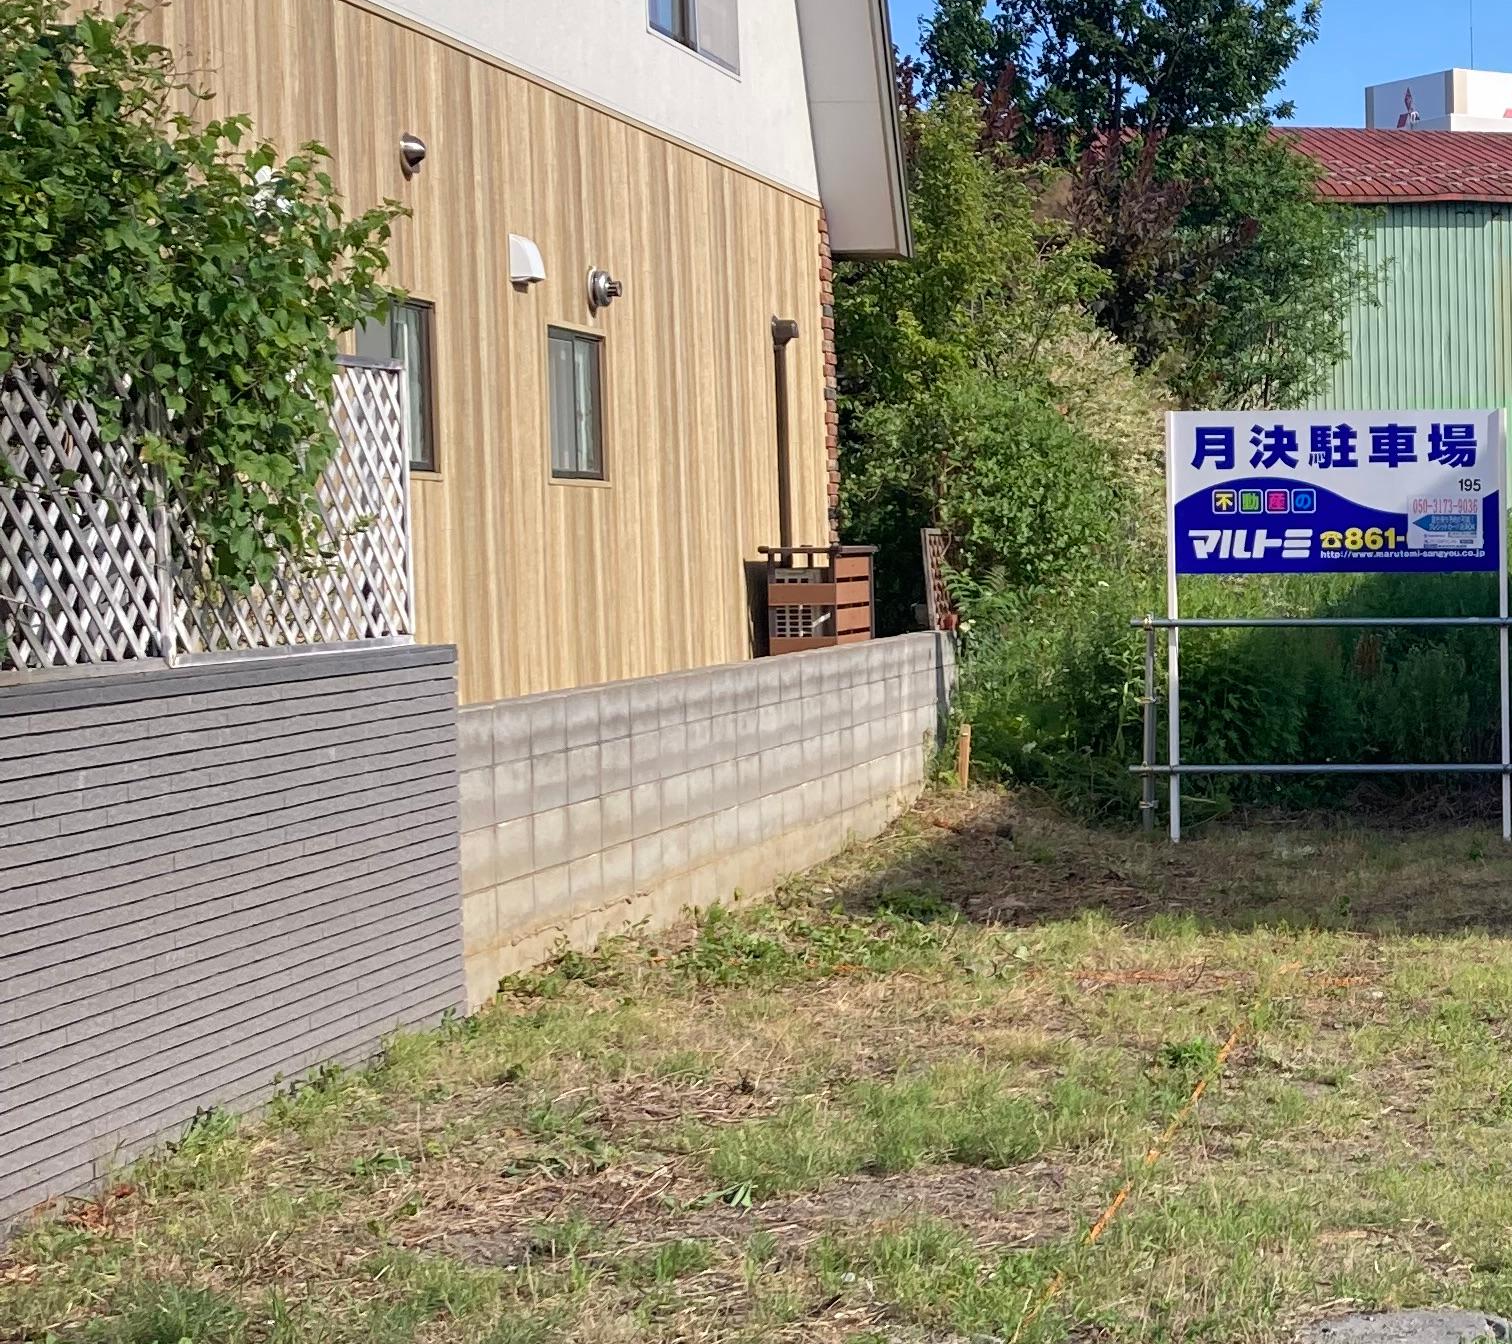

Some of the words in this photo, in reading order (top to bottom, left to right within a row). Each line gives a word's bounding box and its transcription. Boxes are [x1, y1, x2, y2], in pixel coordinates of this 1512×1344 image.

[1190, 423, 1478, 470] 月決駐車場
[1458, 478, 1482, 492] 195
[1214, 490, 1315, 513] 不動産の
[1188, 529, 1313, 559] マルトミ
[1344, 527, 1407, 550] 861-
